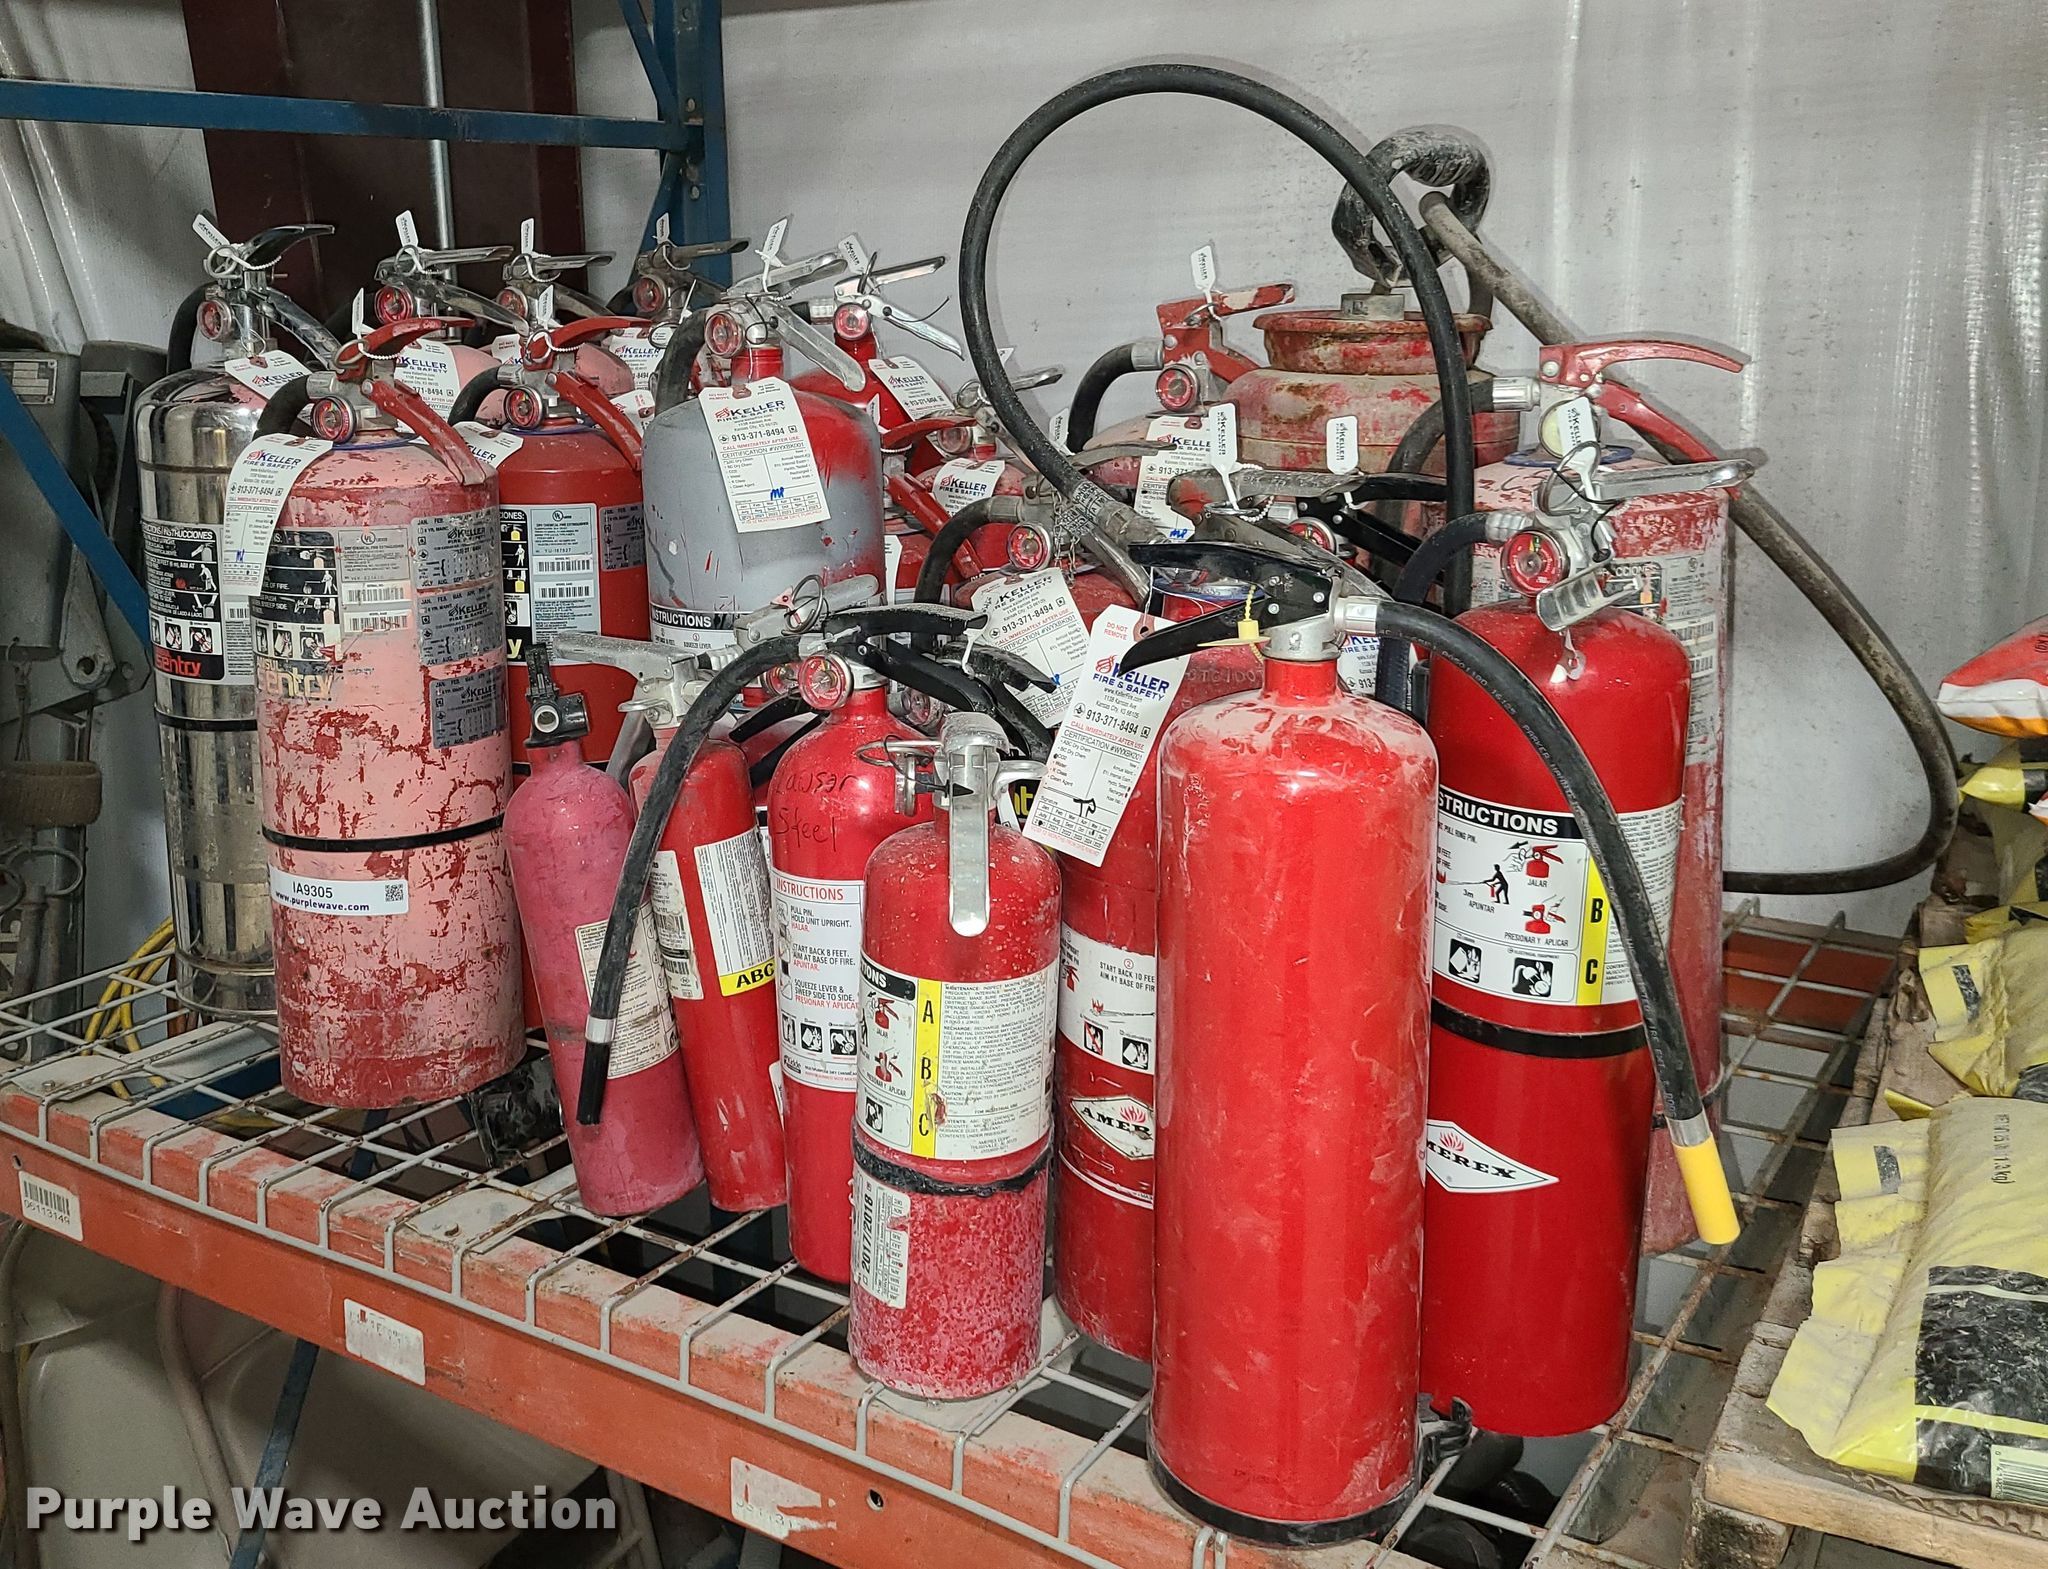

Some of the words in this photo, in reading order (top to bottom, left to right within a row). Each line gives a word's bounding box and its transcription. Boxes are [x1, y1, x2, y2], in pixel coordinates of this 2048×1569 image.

[624, 346, 661, 354] KELLER
[401, 356, 447, 370] KELLER
[895, 375, 926, 384] KELLER
[731, 400, 785, 416] KELLER
[731, 427, 785, 442] 913-371-8494
[257, 452, 302, 465] KELLER
[722, 447, 768, 459] CERTIFICATION
[266, 462, 296, 470] SAFETY
[237, 485, 275, 496] 913-371-8494
[952, 477, 987, 492] KELLER
[999, 575, 1053, 602] KELLER
[459, 601, 488, 614] KELLER
[1001, 603, 1054, 634] 913-371-8494
[1008, 622, 1041, 640] IMMEDIATELY
[1042, 614, 1059, 623] AFTER
[1104, 629, 1128, 640] REMOVE
[1116, 624, 1128, 632] NOT
[1092, 673, 1116, 686] FIRE
[1125, 684, 1165, 702] SAFETY
[1086, 709, 1139, 735] 913-371-8494
[1063, 729, 1110, 750] CERTIFICATION
[1071, 720, 1084, 731] CALL
[1085, 725, 1119, 740] IMMEDIATELY
[1119, 736, 1135, 747] AFTER
[1134, 742, 1144, 750] USE
[1522, 724, 1550, 760] PARKER
[776, 807, 837, 852] Steel
[1455, 829, 1467, 842] RING
[1466, 833, 1477, 844] PIN.
[292, 881, 333, 898] IA9305
[776, 877, 844, 900] INSTRUCTIONS
[1527, 878, 1548, 888] JALAR
[275, 890, 370, 911] www.purplewave.com
[1463, 888, 1474, 899] 3m
[790, 905, 802, 915] PULL
[803, 908, 814, 917] PIN.
[1468, 900, 1495, 914] APUNTAR
[1590, 898, 1604, 924] B
[790, 914, 805, 923] HOLD
[806, 917, 820, 926] UNIT
[821, 919, 852, 928] UPRIGHT.
[791, 922, 810, 932] HALAR.
[1504, 931, 1536, 945] PRESIONAR
[1536, 935, 1541, 945] Y
[1544, 937, 1569, 947] APLICAR
[792, 944, 808, 952] START
[809, 946, 825, 956] BACK
[826, 949, 831, 957] 8
[793, 951, 803, 959] AIM
[813, 955, 828, 964] BASE
[829, 957, 838, 965] OF
[839, 958, 856, 966] FIRE.
[793, 959, 820, 971] APUNTAR.
[736, 963, 775, 989] ABC
[1099, 961, 1116, 973] START
[1117, 967, 1133, 979] BACK
[1135, 973, 1143, 981] 10
[1585, 958, 1599, 985] C
[794, 978, 817, 990] SQUEEZE
[818, 984, 838, 993] LEVER
[1099, 971, 1110, 980] AIM
[1110, 975, 1118, 983] AT
[1119, 977, 1134, 988] BASE
[1135, 981, 1143, 989] OF
[795, 986, 812, 997] SWEEP
[813, 991, 826, 1000] SIDE
[827, 993, 837, 1001] TO
[837, 993, 855, 1002] SIDE.
[795, 994, 825, 1008] PRESIONAR
[826, 1000, 831, 1008] Y
[922, 1000, 934, 1025] A
[920, 1057, 932, 1081] B
[888, 1083, 907, 1097] APLICAR
[918, 1113, 930, 1137] C
[861, 1194, 874, 1274] 2017/2018
